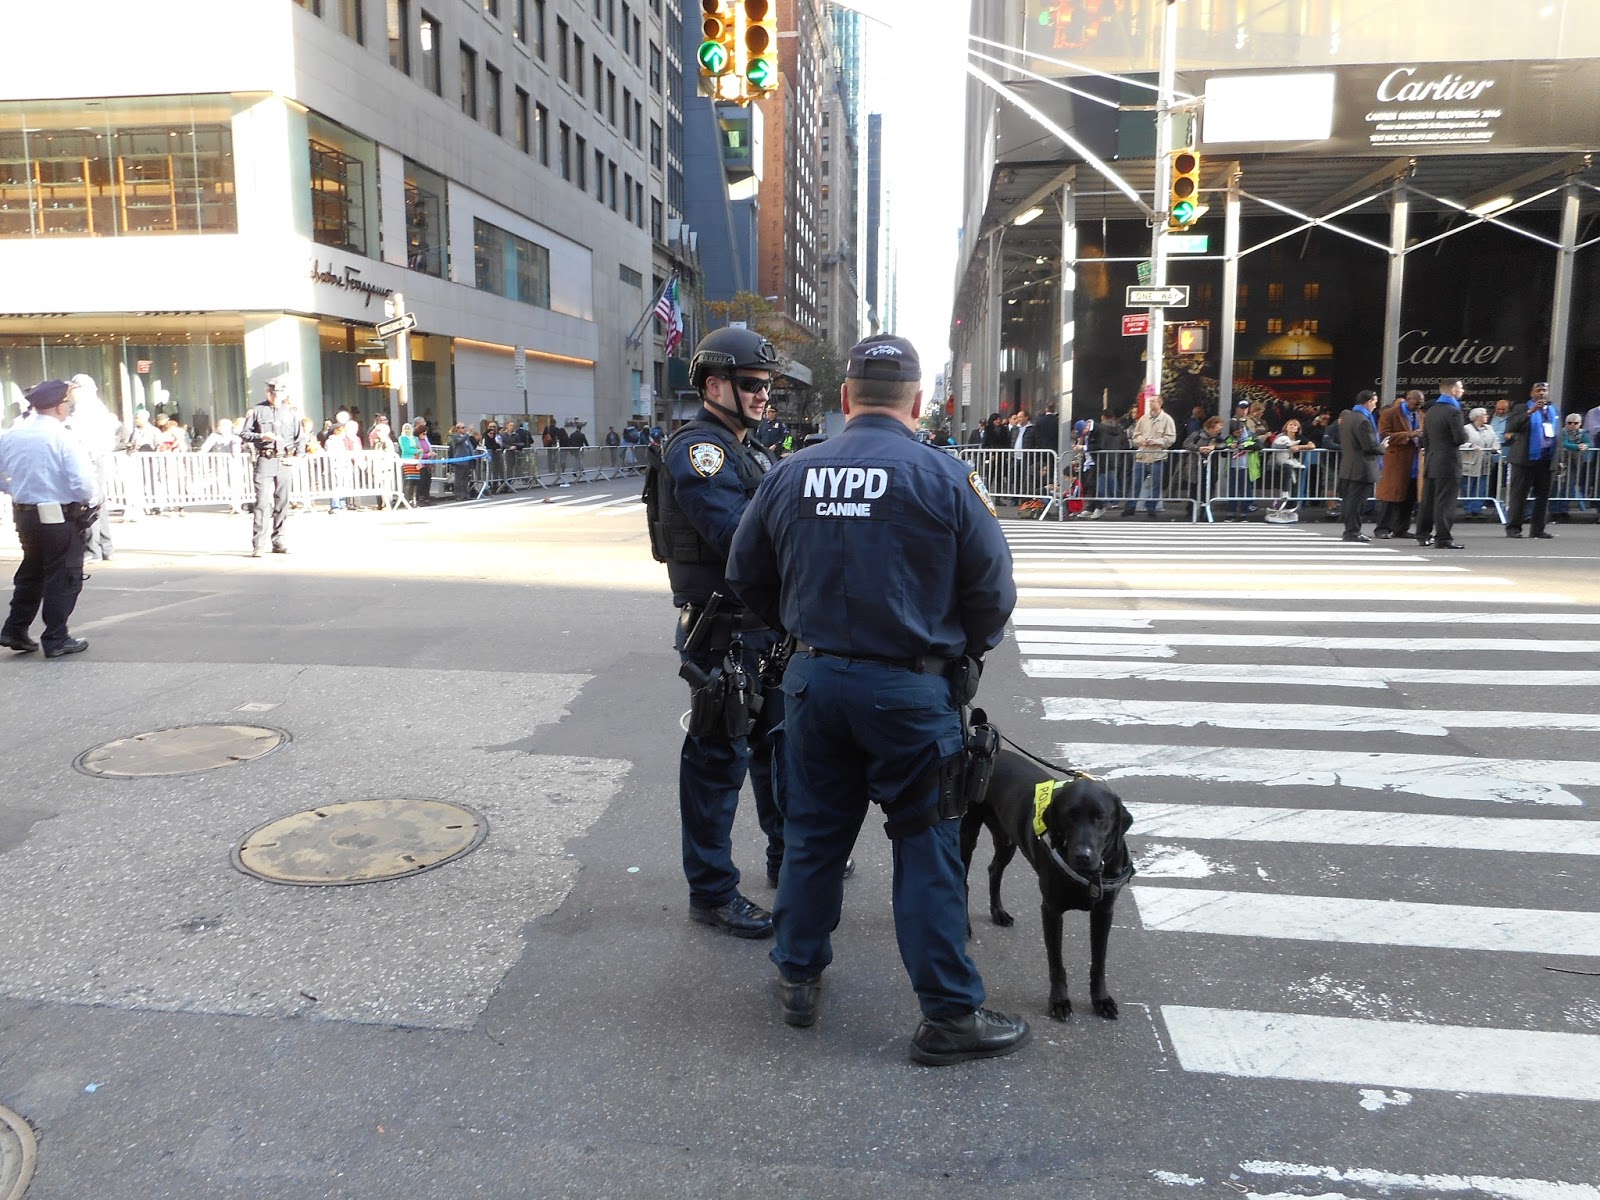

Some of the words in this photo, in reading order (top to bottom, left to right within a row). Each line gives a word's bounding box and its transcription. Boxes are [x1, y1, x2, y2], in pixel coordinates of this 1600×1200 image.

[1376, 67, 1495, 102] Cartier
[1135, 292, 1153, 301] ONE
[1160, 292, 1179, 301] WAY
[1397, 329, 1515, 365] Cartier
[1410, 376, 1446, 386] MANSIO
[1456, 375, 1500, 386] EOPENING
[1502, 375, 1524, 386] 2016
[803, 467, 889, 500] NYPD
[815, 502, 871, 517] CANINE
